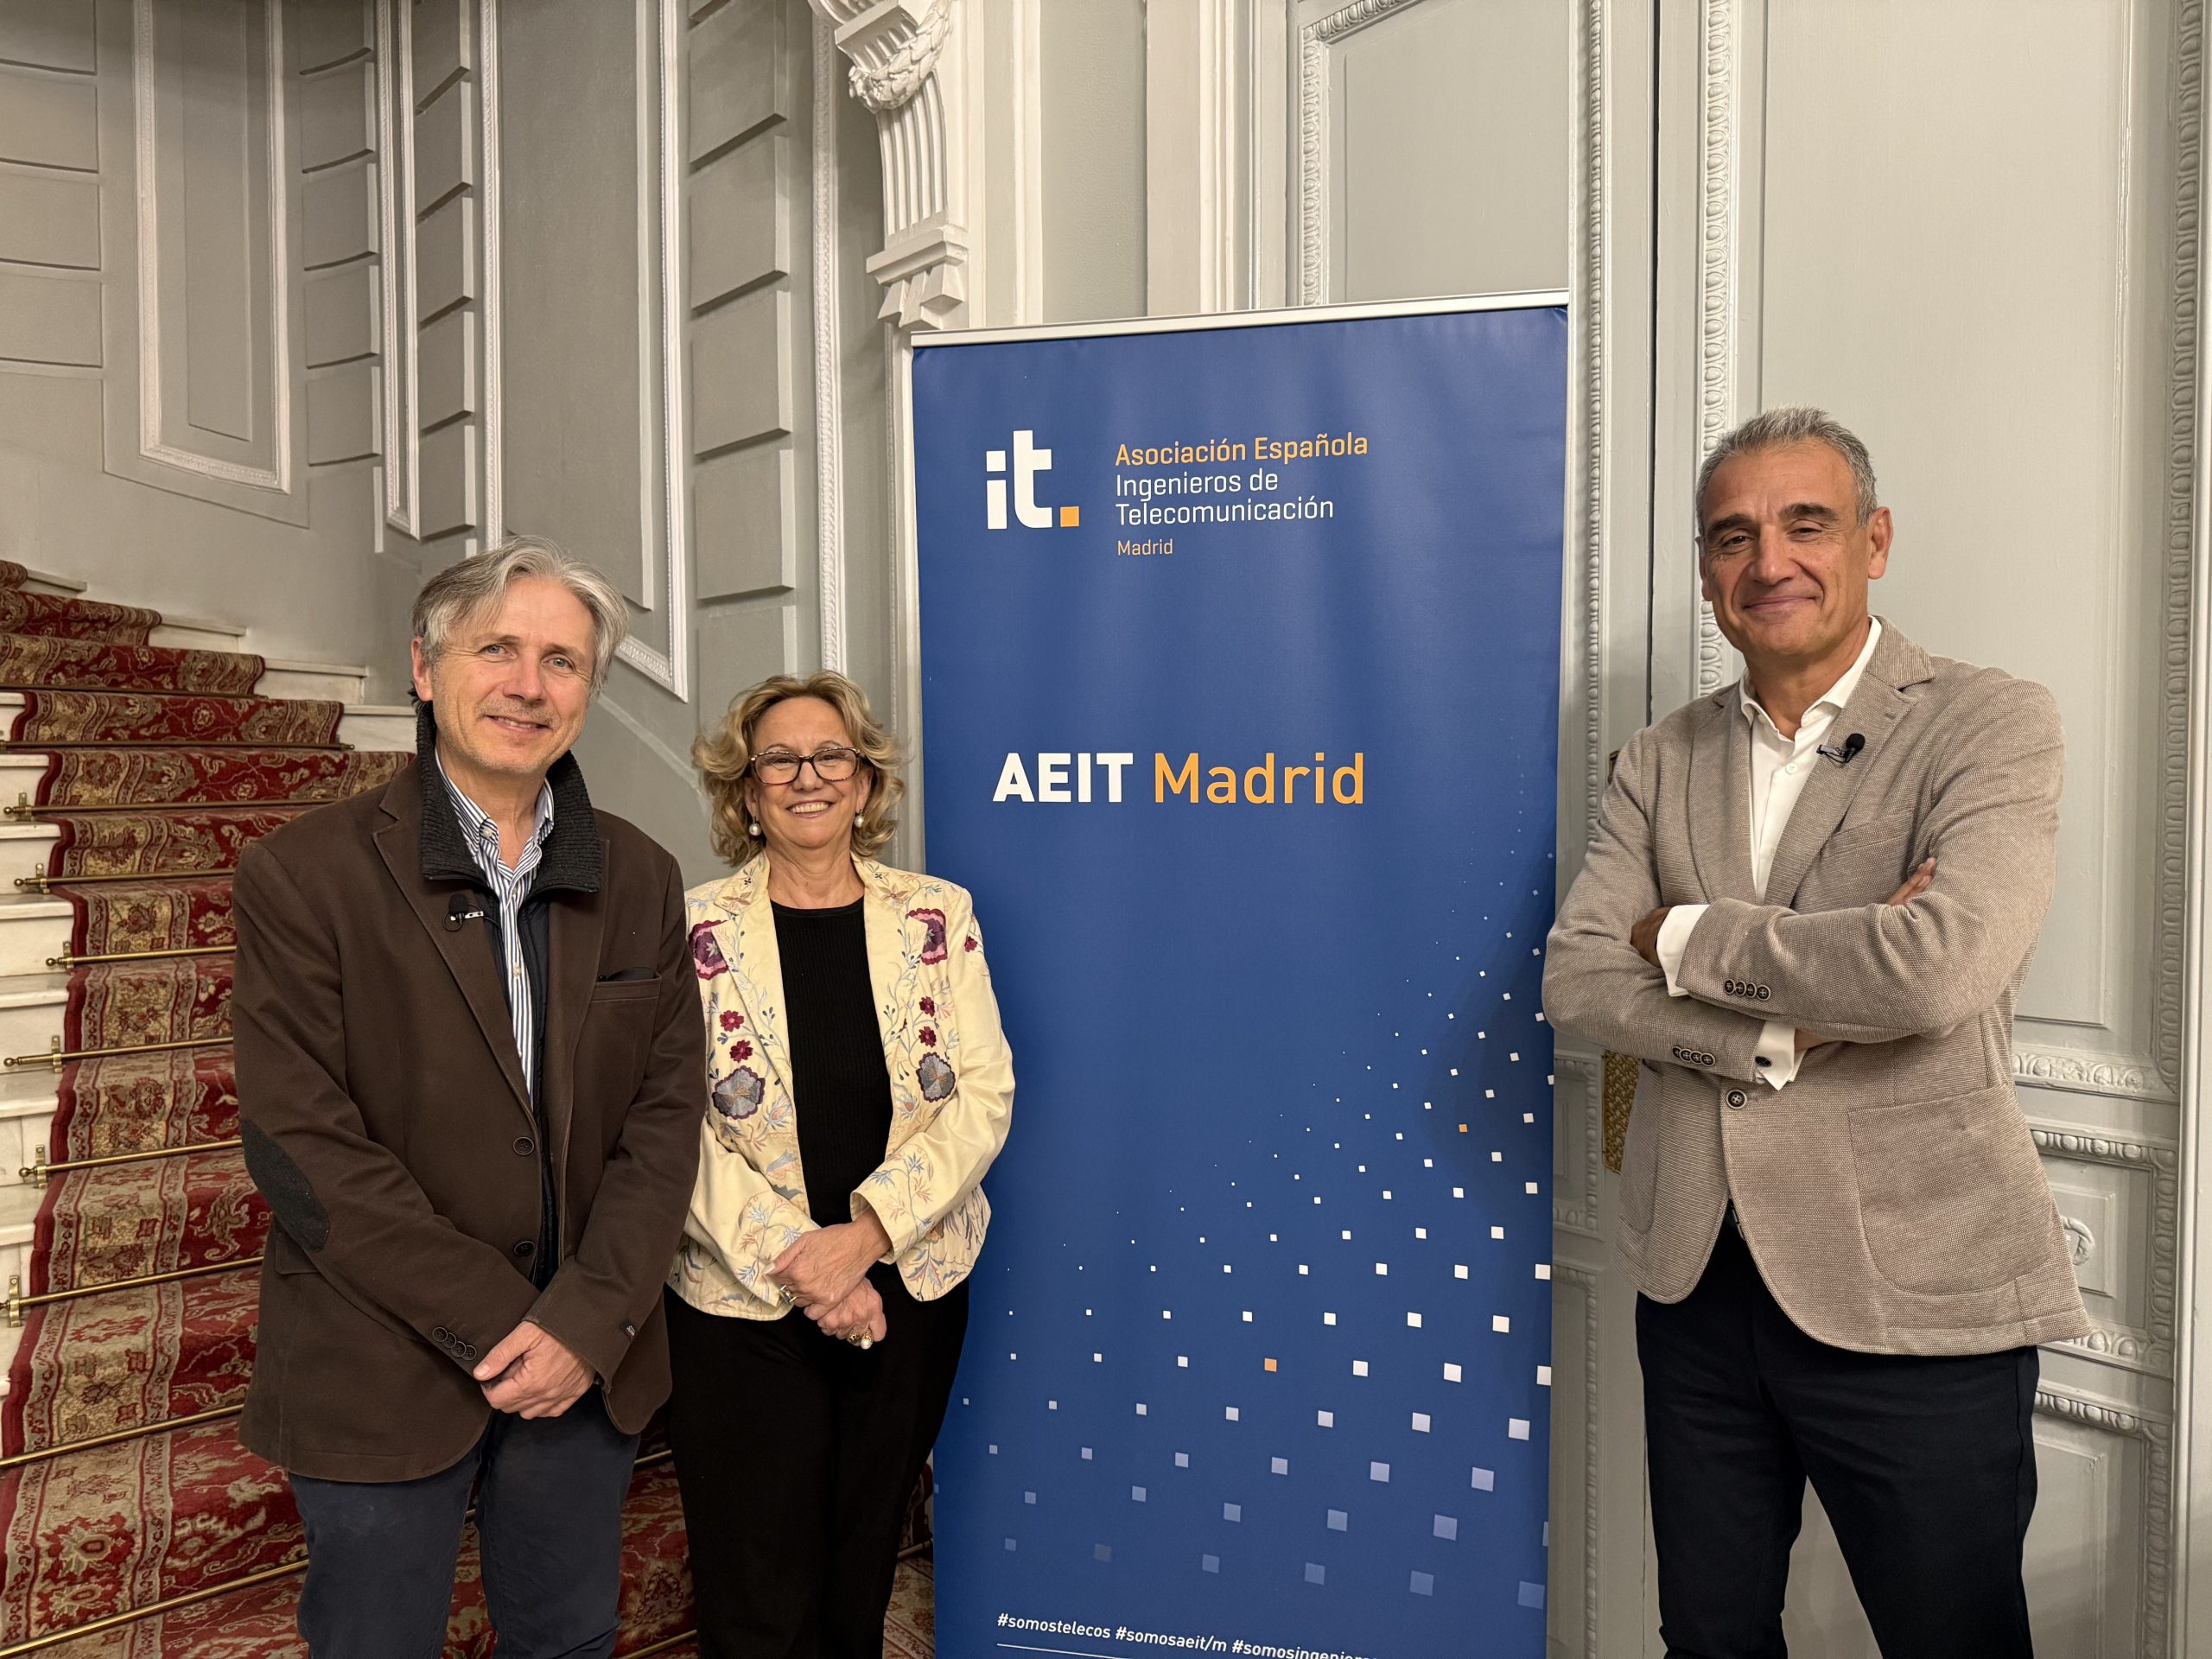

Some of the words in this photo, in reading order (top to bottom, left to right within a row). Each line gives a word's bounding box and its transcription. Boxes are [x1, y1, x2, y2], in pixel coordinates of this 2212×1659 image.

[1115, 438, 1246, 467] Asociación
[1255, 431, 1369, 464] Española
[1116, 471, 1242, 502] Ingenieros
[1249, 467, 1279, 492] de
[1115, 494, 1334, 526] Telecomunicación
[1116, 537, 1173, 556] Madrid
[992, 752, 1134, 803] AEIT
[1154, 752, 1363, 804] Madrid
[997, 1612, 1111, 1640] #somostelecos
[1116, 1626, 1227, 1652] #somosaeit/m
